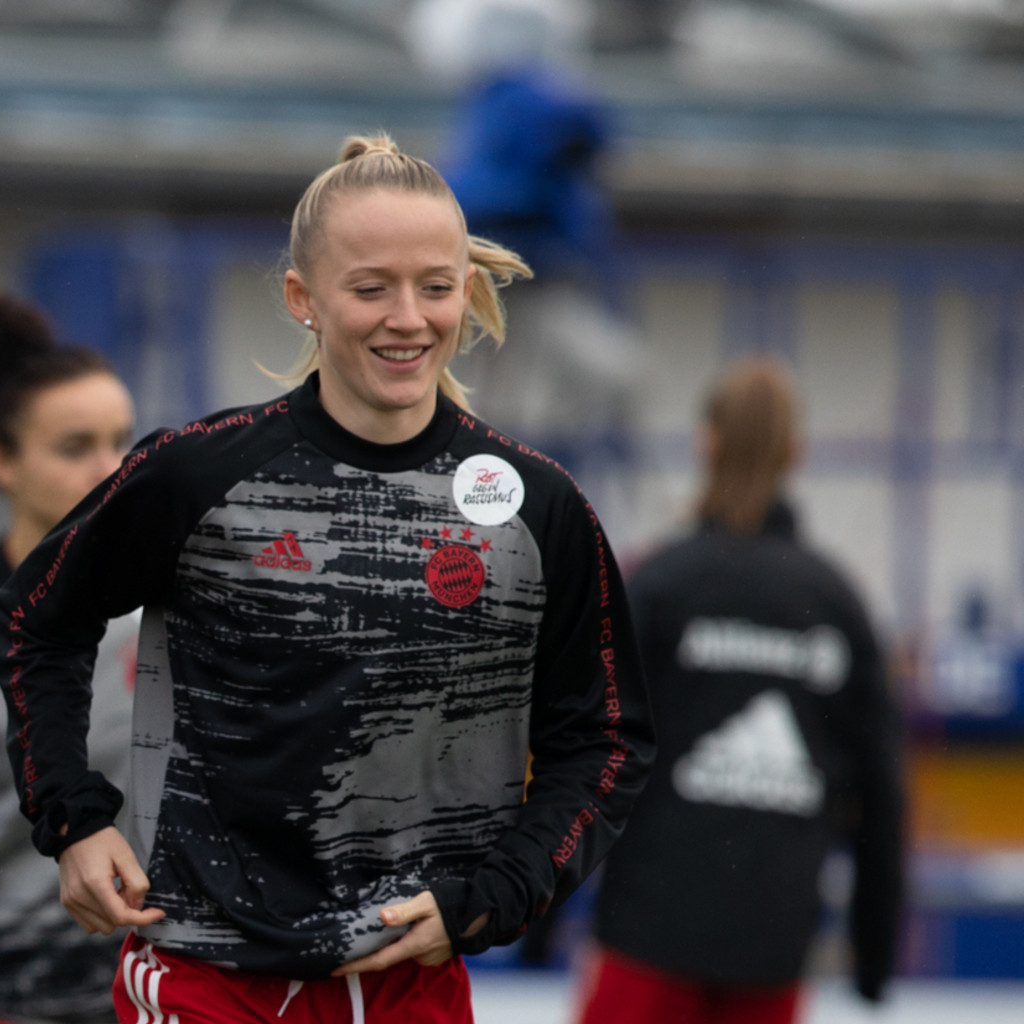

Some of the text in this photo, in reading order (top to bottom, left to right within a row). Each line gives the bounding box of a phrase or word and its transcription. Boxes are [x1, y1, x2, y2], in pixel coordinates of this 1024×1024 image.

[28, 583, 47, 607] FC
[156, 430, 175, 451] FC
[180, 413, 254, 436] BAYERN
[264, 400, 289, 416] FC
[253, 553, 312, 573] adidas
[431, 549, 481, 572] FC BAYERN
[600, 617, 613, 644] FC
[600, 648, 623, 726] BAYERN
